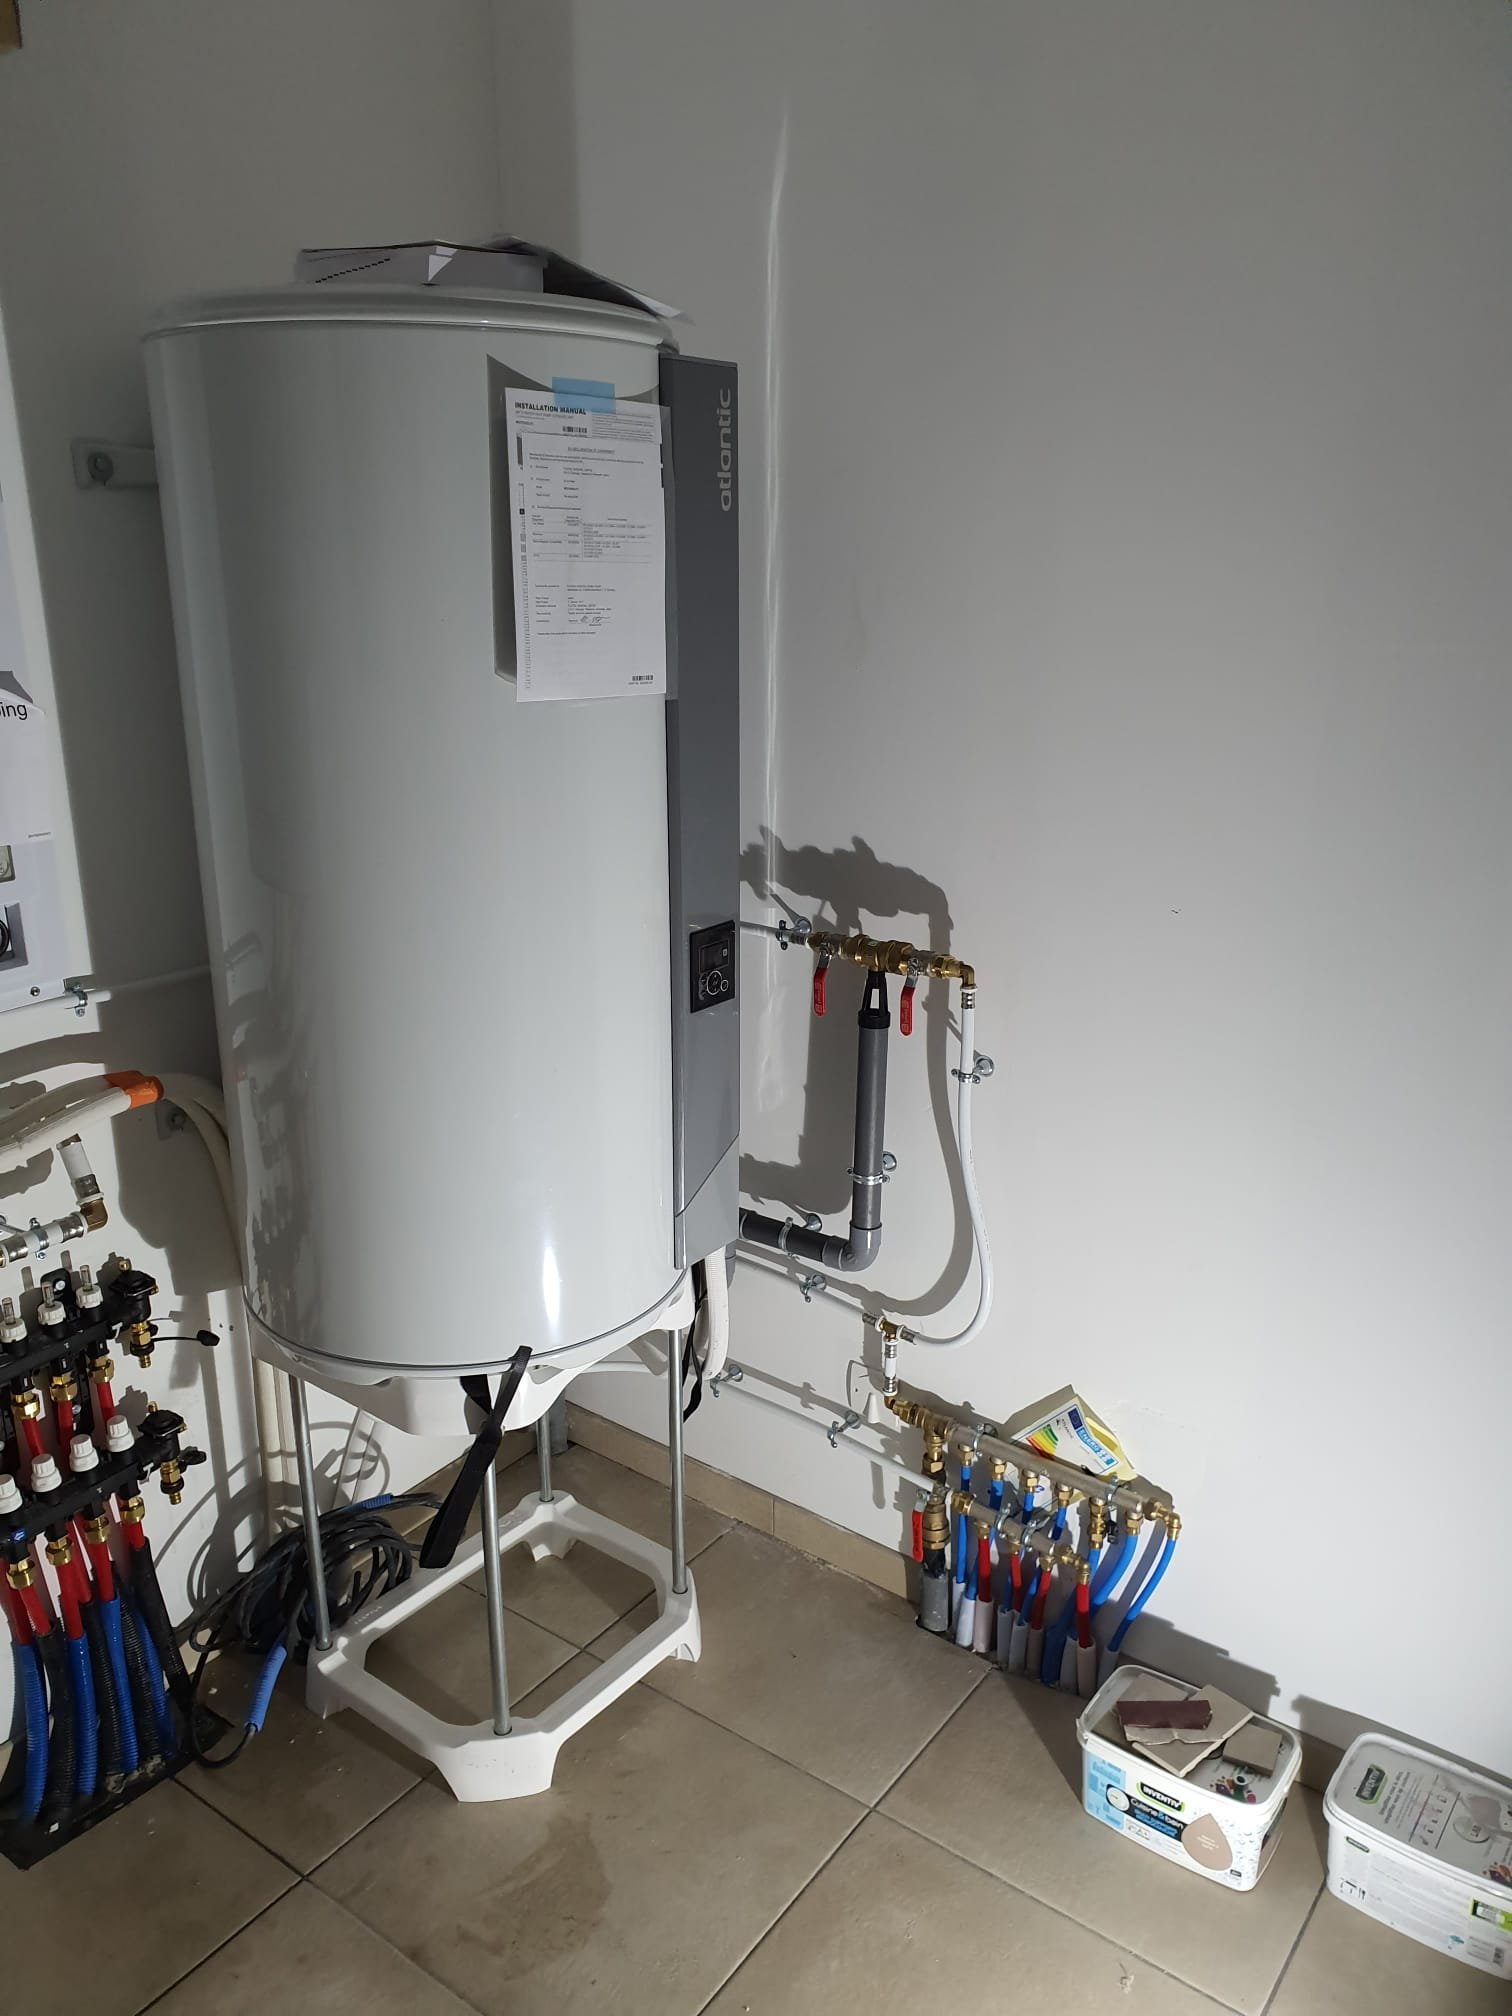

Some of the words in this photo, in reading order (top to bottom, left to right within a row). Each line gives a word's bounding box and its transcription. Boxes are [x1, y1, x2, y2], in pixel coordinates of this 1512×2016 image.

[514, 401, 559, 412] INSTALLATION
[559, 407, 587, 416] MANUAL
[717, 387, 732, 512] atlantic
[0, 702, 28, 721] ing
